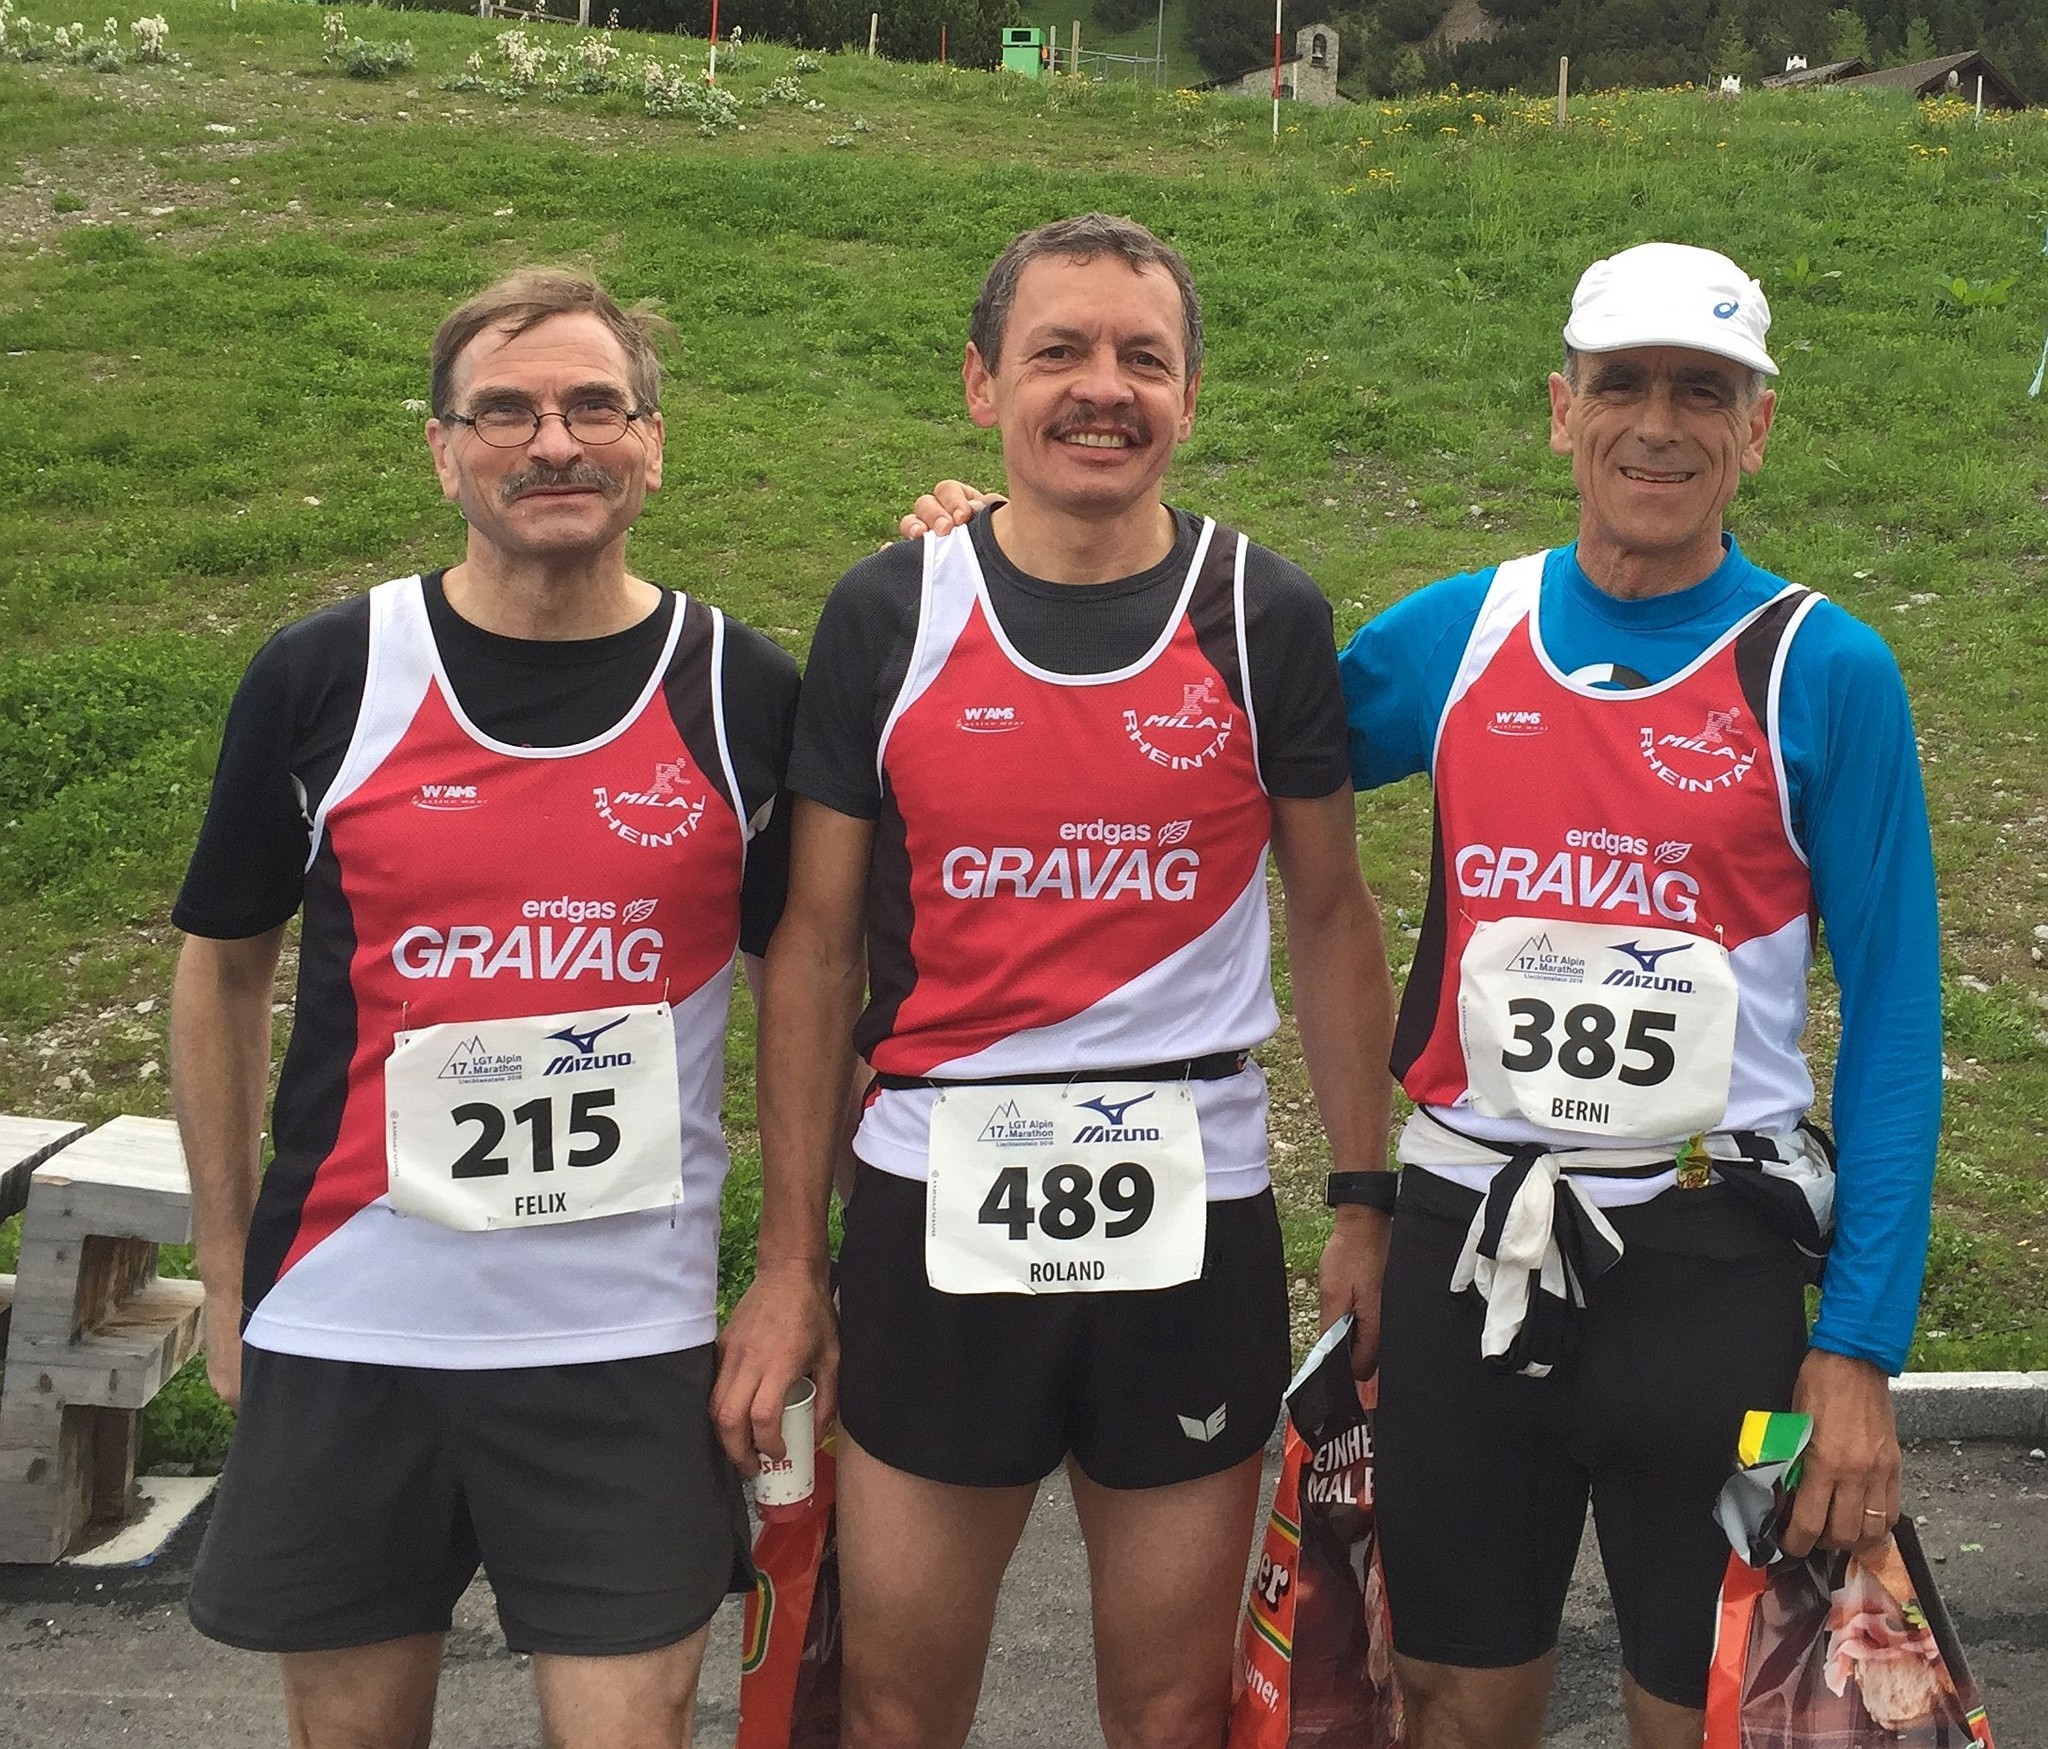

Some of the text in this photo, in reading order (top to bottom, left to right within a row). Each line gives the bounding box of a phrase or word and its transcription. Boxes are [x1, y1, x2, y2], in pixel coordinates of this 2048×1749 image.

[1123, 709, 1233, 770] RHEINTAL
[1640, 727, 1758, 793] RHEINTAL
[593, 786, 707, 847] RHEINTAL
[1059, 818, 1152, 846] erdgas
[1565, 827, 1648, 857] erdgas
[942, 845, 1200, 901] GRAVAG
[1454, 843, 1700, 924] GRAVAG
[522, 895, 616, 924] erdgas
[391, 924, 664, 983] GRAVAG
[1539, 954, 1585, 967] LGT Alpin
[1539, 963, 1584, 976] Marathon
[1601, 969, 1693, 995] MIZUNO
[1501, 997, 1676, 1087] 385
[473, 1054, 522, 1066] LGT Alpin
[473, 1063, 522, 1075] Marathon
[542, 1052, 632, 1077] MIZUNO
[1008, 1119, 1054, 1130] LGT Alpin
[1550, 1097, 1610, 1124] BERNI
[450, 1088, 621, 1179] 215
[1009, 1129, 1054, 1138] Marathon
[1072, 1125, 1160, 1144] MIZUNO
[514, 1192, 568, 1217] FELIX
[977, 1162, 1155, 1240] 489
[1029, 1260, 1105, 1283] ROLAND
[1307, 1469, 1357, 1505] MAL
